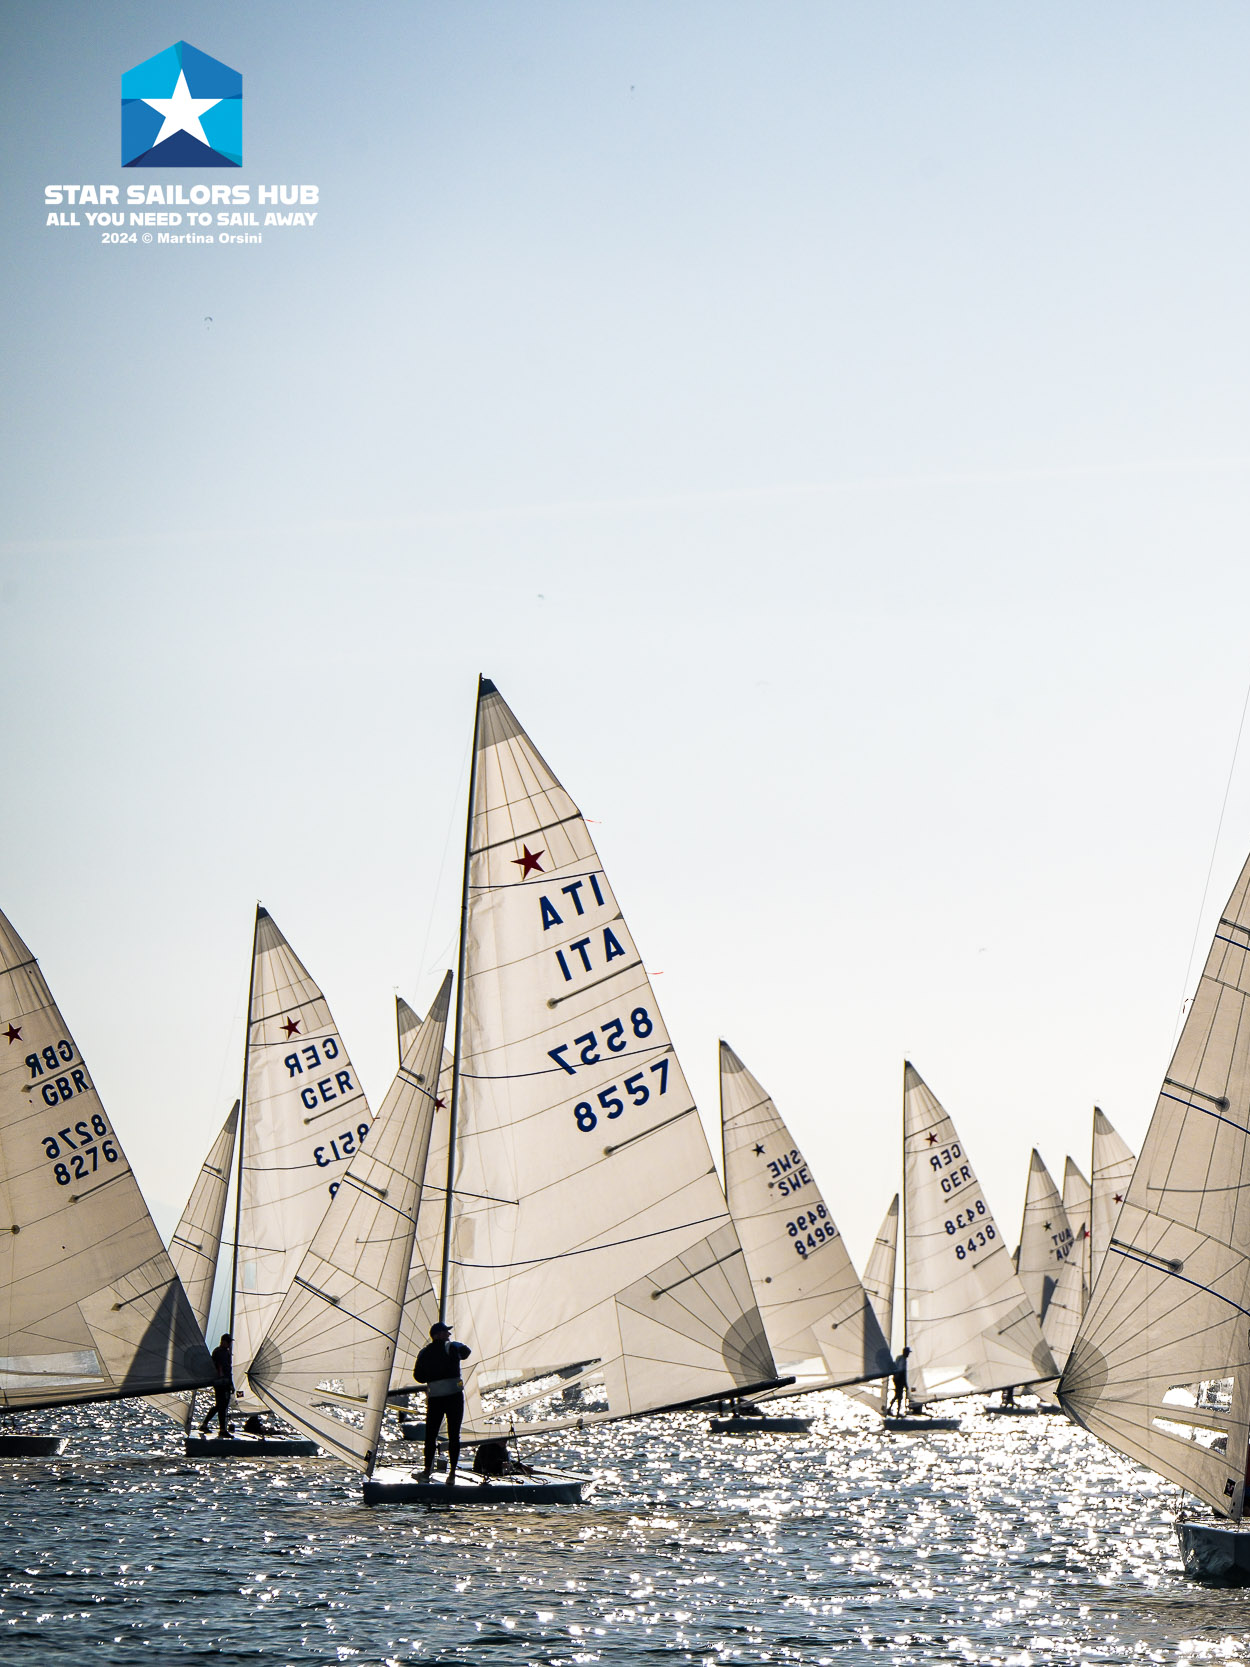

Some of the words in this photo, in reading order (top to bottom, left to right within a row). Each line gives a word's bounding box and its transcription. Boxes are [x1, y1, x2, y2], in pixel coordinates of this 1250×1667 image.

[555, 927, 626, 982] ITA
[41, 1069, 89, 1107] GBR
[301, 1070, 354, 1109] GER
[574, 1058, 669, 1133] 8557
[53, 1140, 119, 1186] 8276
[777, 1168, 811, 1196] SWE
[940, 1165, 971, 1193] GER
[794, 1221, 834, 1256] 8496
[955, 1225, 995, 1260] 8438
